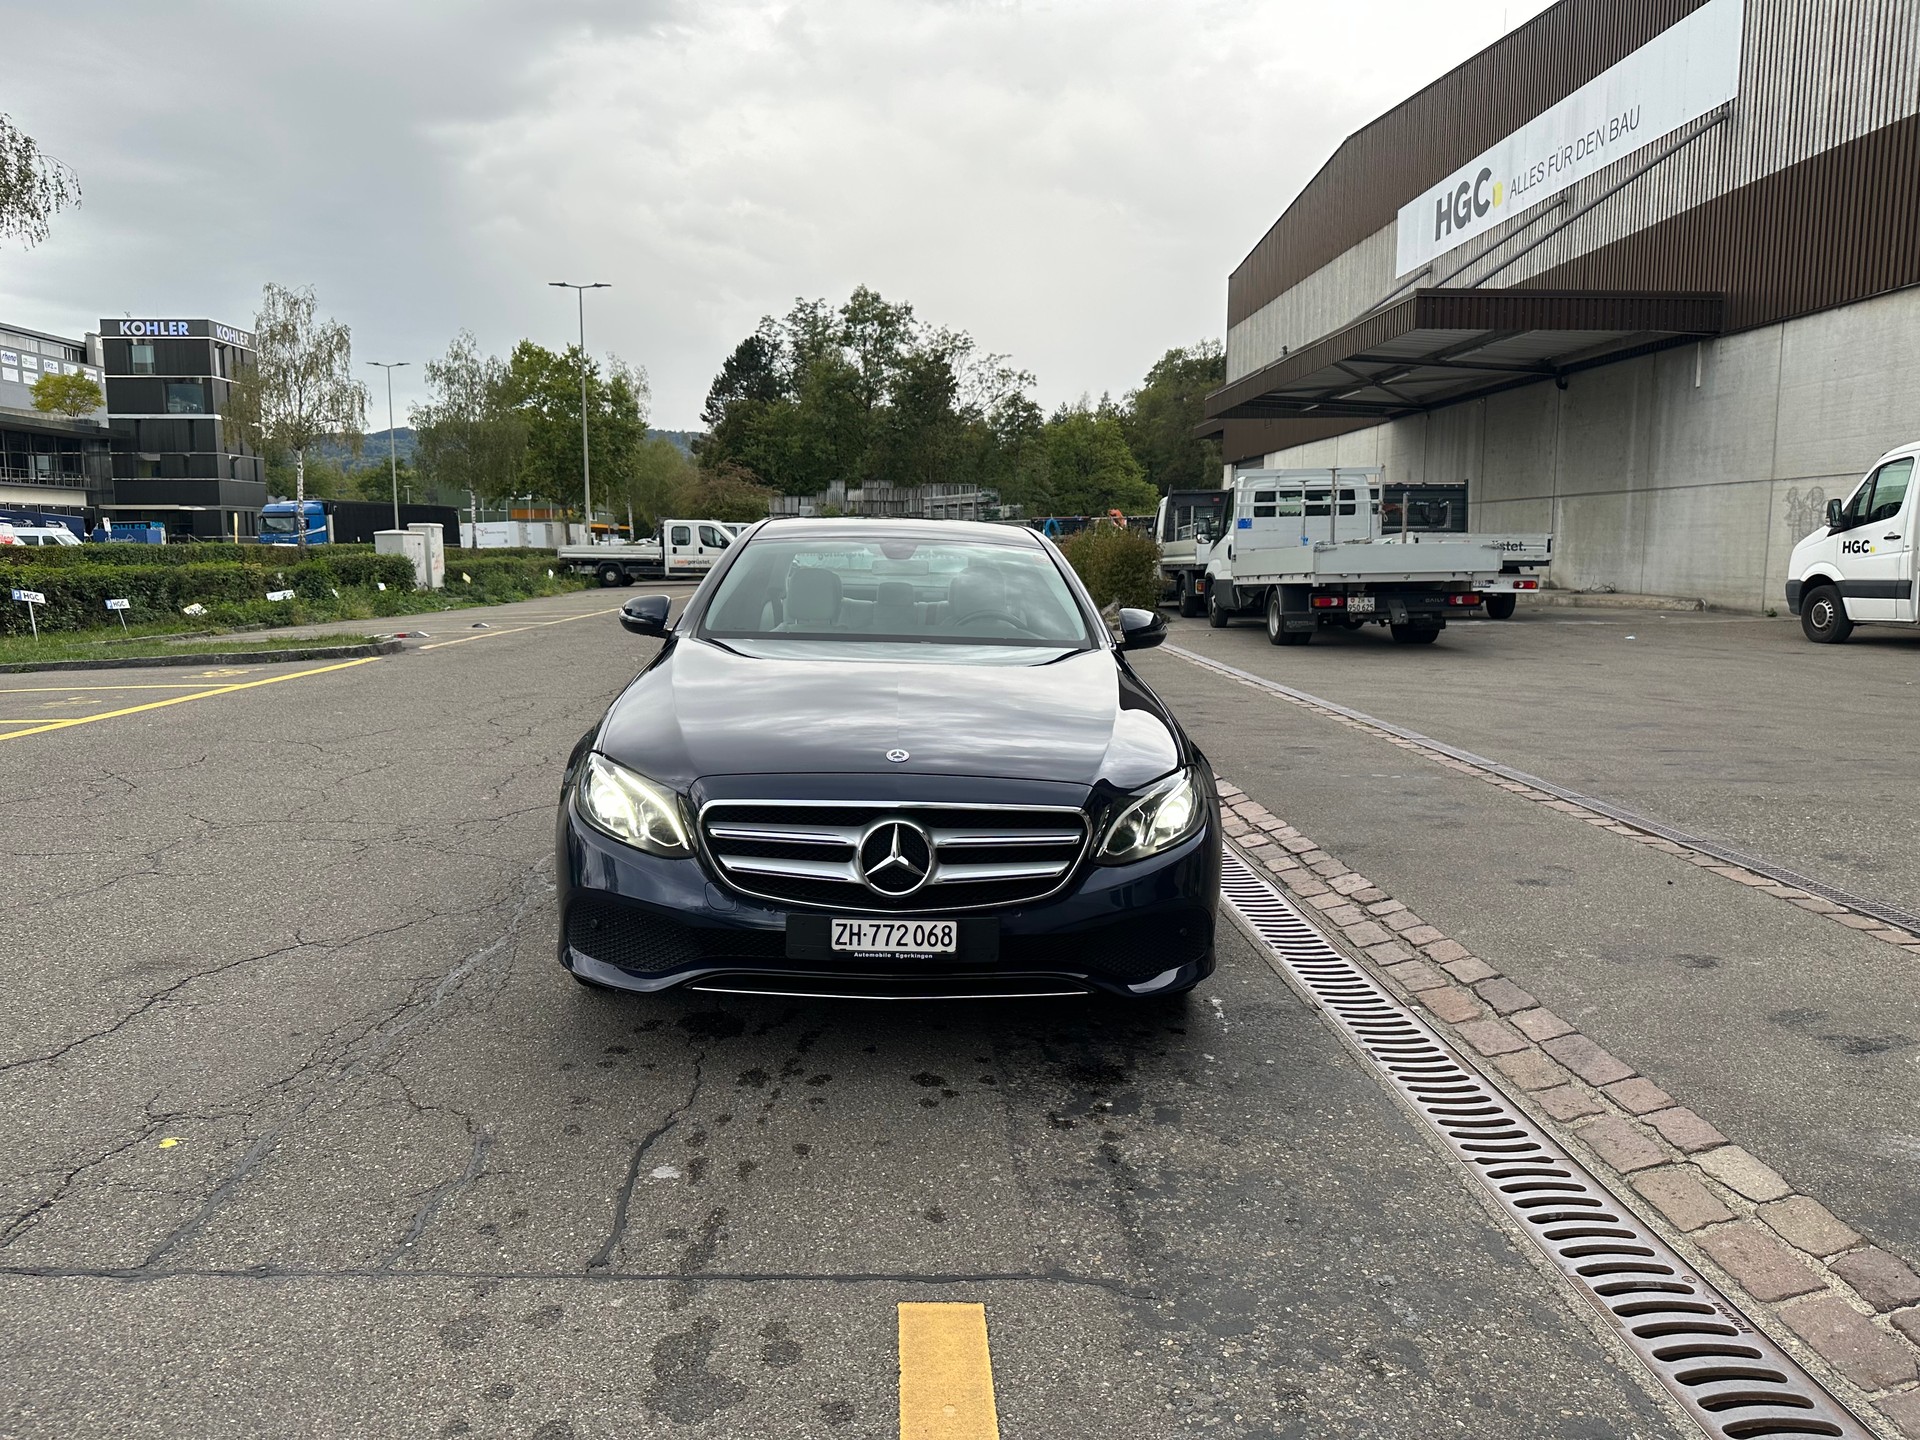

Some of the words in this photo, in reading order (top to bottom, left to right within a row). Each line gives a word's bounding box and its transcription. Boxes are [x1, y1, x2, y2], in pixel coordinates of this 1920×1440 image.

[1434, 167, 1493, 242] HGC
[1509, 165, 1545, 200] ALLES
[1547, 146, 1573, 178] FÜR
[1575, 124, 1605, 162] DEN
[1608, 104, 1641, 143] BAU
[119, 320, 190, 336] KOHLER
[216, 324, 250, 346] KOHLER
[1842, 539, 1870, 554] HGC
[23, 592, 40, 601] HGC
[112, 600, 126, 608] HGC
[1348, 603, 1360, 612] 950
[1361, 603, 1374, 612] 625
[895, 952, 933, 960] Egerkingen
